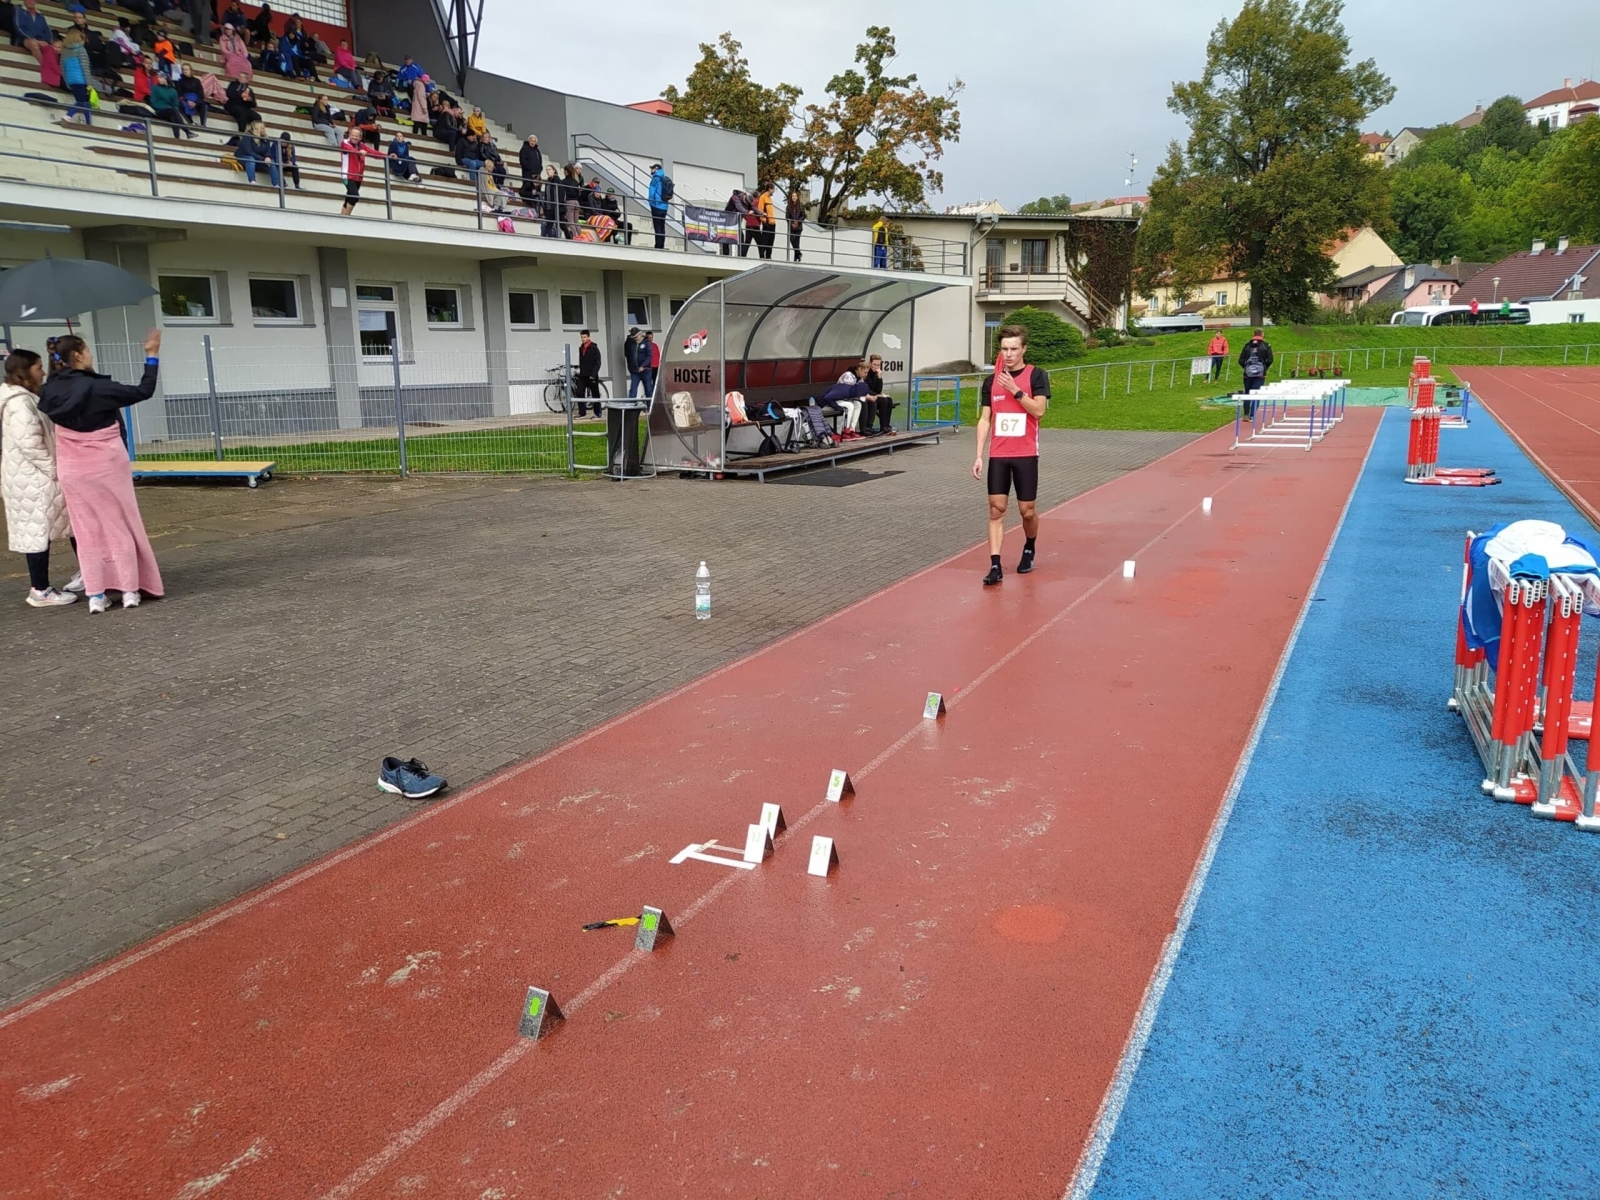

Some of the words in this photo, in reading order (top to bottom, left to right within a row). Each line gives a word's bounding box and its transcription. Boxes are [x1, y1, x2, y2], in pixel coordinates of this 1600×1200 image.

[673, 364, 712, 384] HOSTÉ
[1000, 418, 1020, 432] 67
[833, 776, 840, 787] 5
[814, 842, 827, 856] 21
